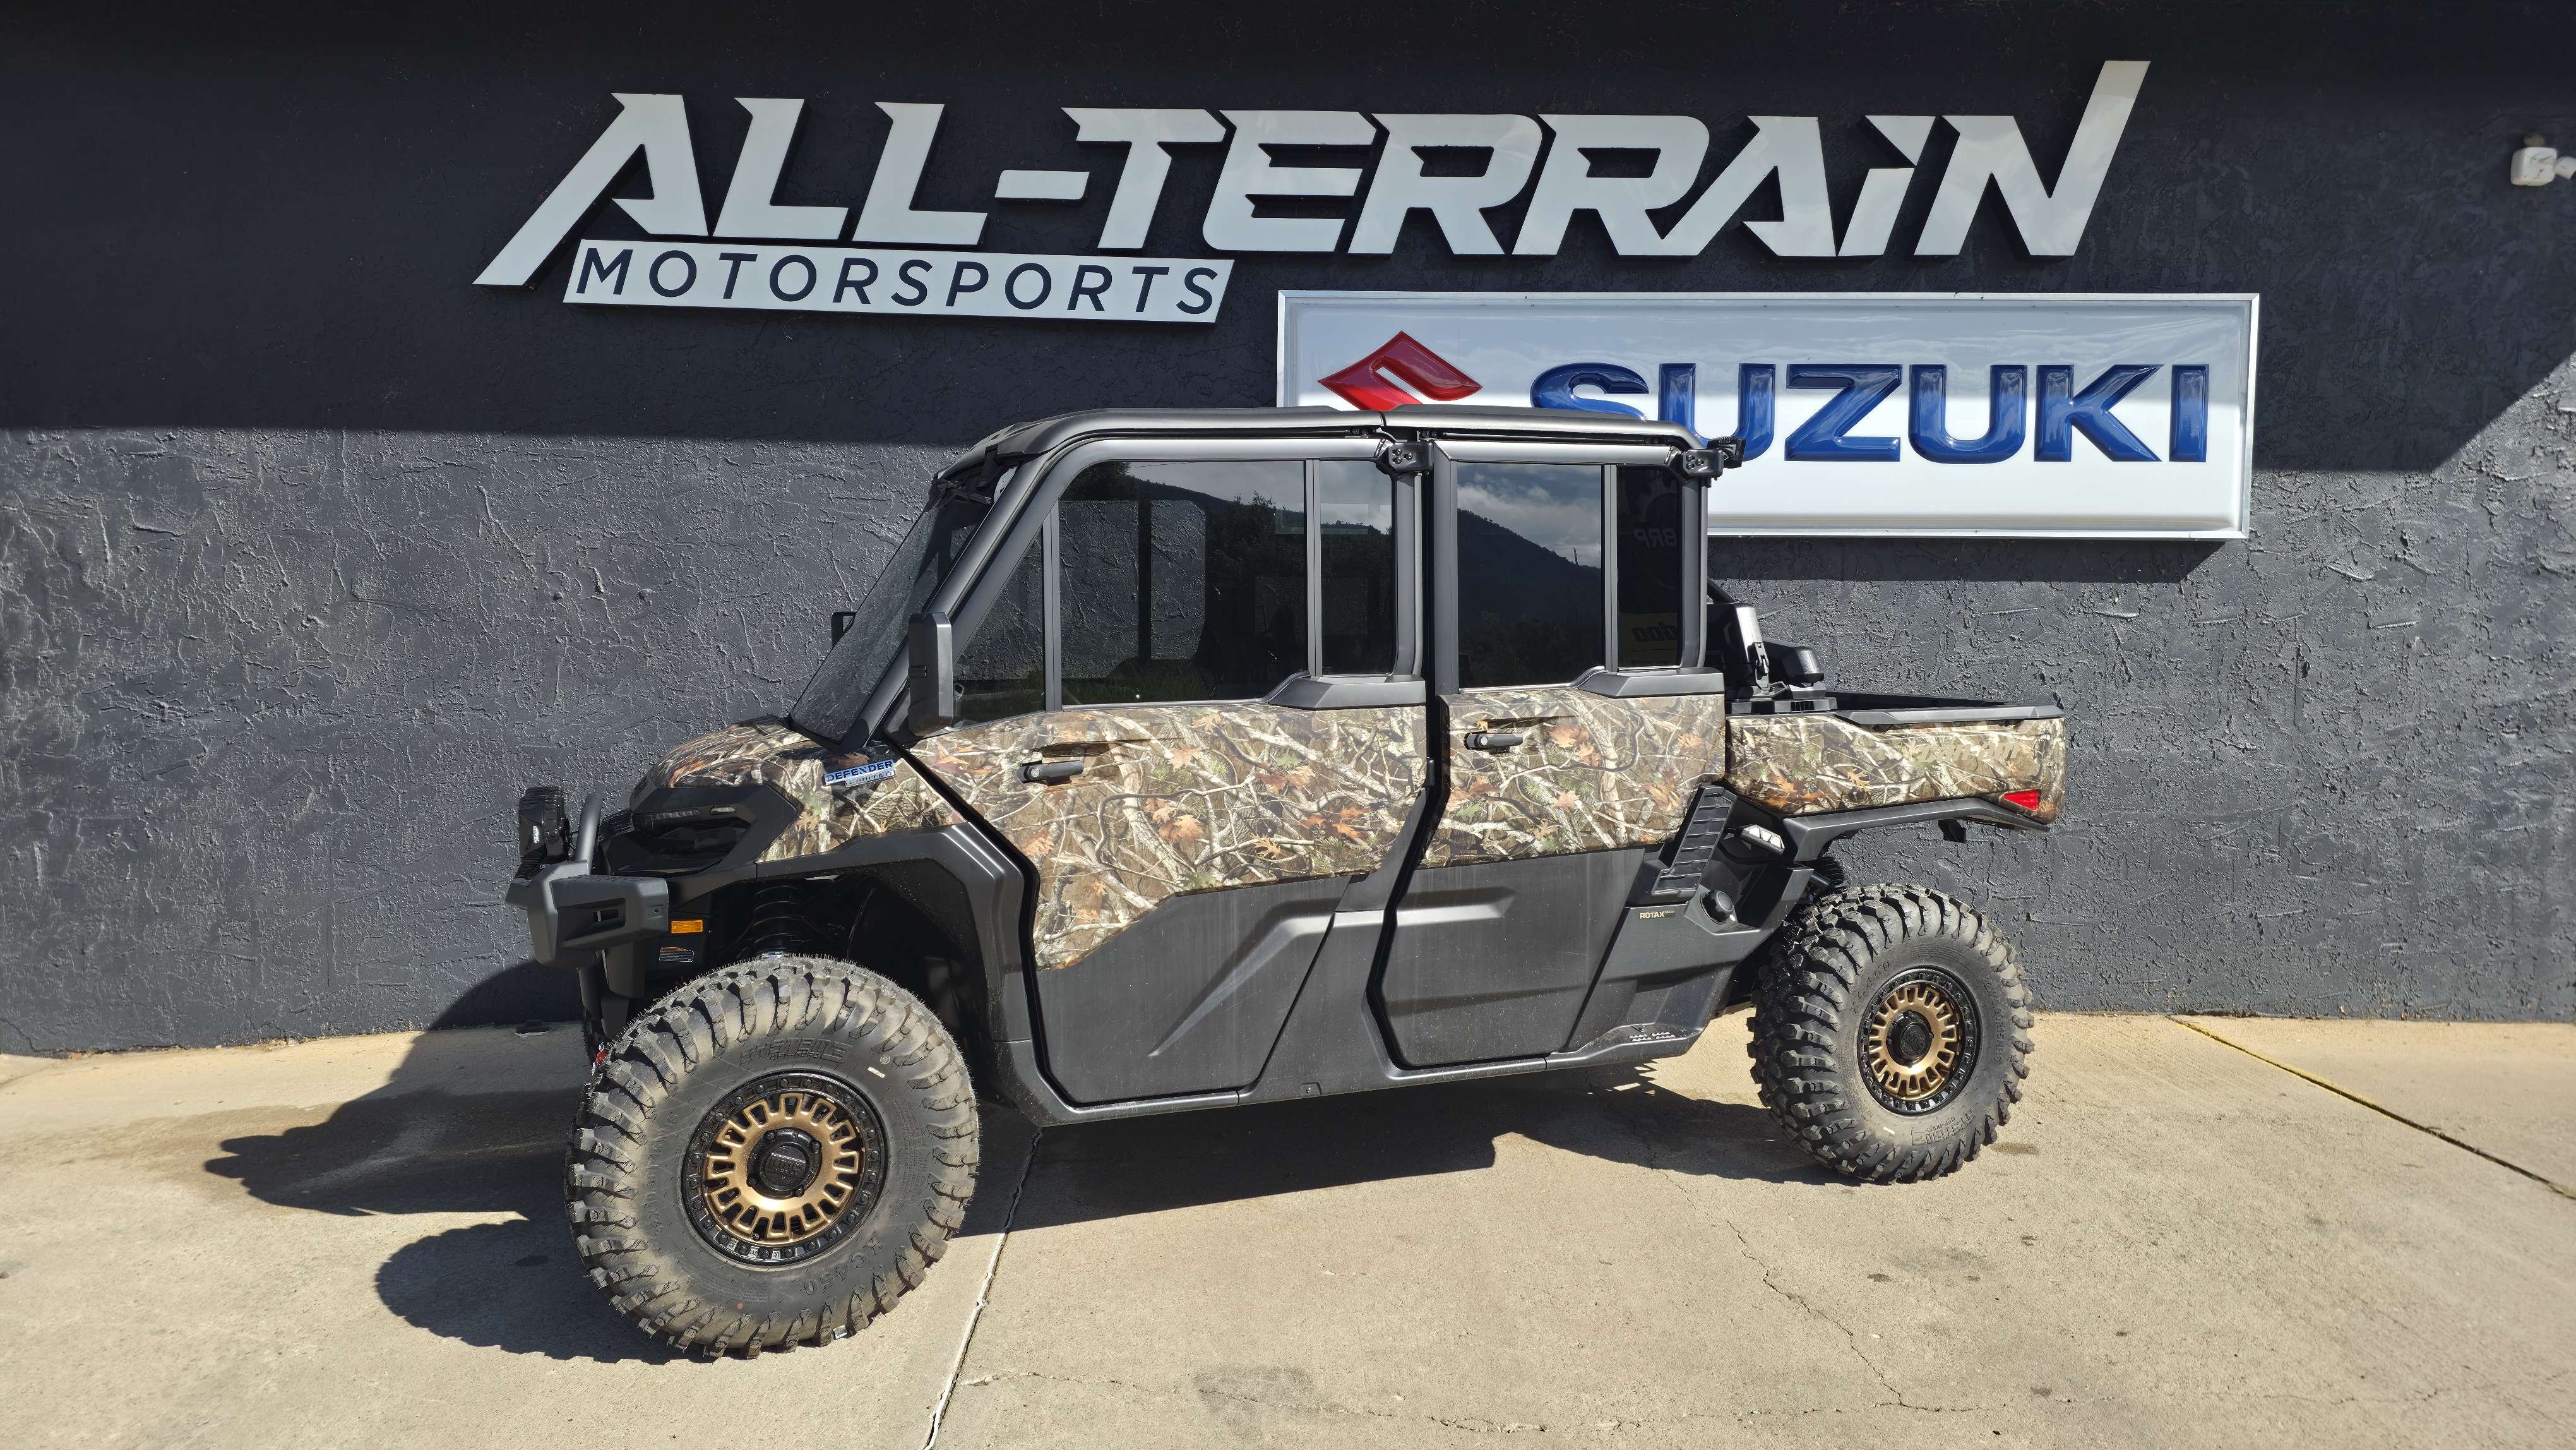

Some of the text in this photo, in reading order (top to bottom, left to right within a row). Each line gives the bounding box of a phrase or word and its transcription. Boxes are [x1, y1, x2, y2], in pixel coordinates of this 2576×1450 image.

[473, 61, 2150, 285] ALL-TERRAIN
[576, 246, 1219, 315] MOTORSPORTS
[1530, 362, 2208, 464] SUZUKI
[1918, 742, 2020, 763] can-am
[825, 760, 893, 782] DEFENDER
[849, 772, 892, 784] LIMITED
[1639, 911, 1665, 920] ROTAX
